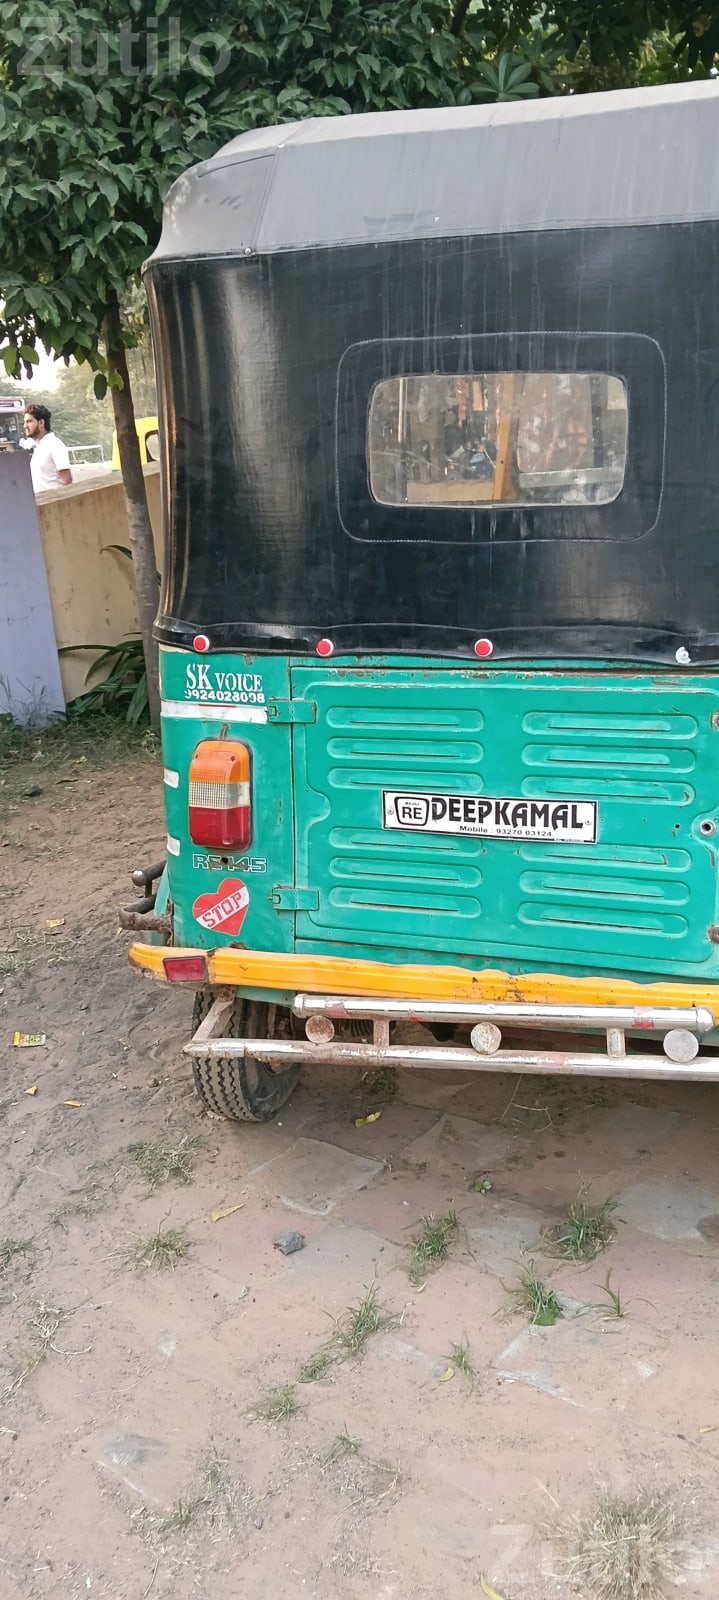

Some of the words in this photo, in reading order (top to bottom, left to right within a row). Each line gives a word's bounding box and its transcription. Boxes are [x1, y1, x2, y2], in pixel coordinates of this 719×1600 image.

[186, 663, 213, 690] SK
[214, 672, 263, 692] VOICE
[402, 806, 423, 820] RE
[431, 797, 584, 830] DEEPKAMAL
[459, 825, 488, 833] Mobile
[202, 891, 242, 929] STOP
